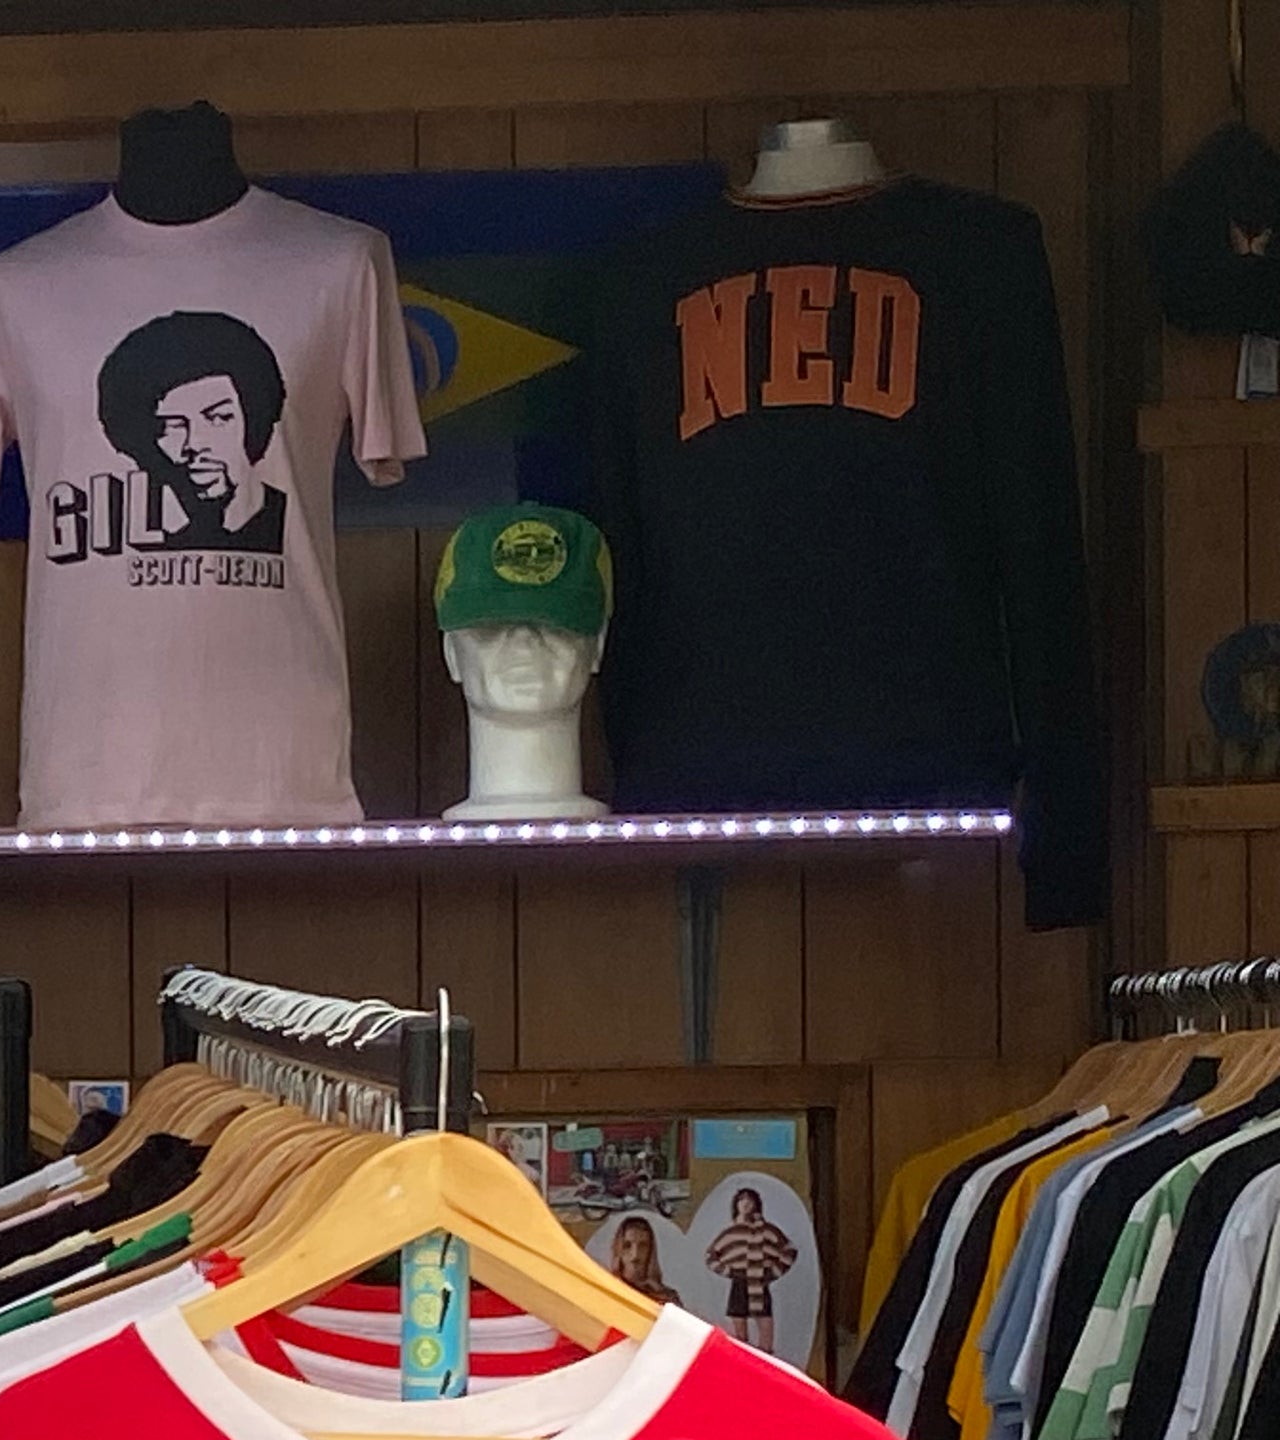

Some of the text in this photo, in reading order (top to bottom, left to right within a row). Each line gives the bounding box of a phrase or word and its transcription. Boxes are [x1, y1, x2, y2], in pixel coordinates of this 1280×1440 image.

[676, 265, 921, 441] NED
[45, 470, 165, 565] GIL
[127, 555, 286, 589] SCOTT-HERON
